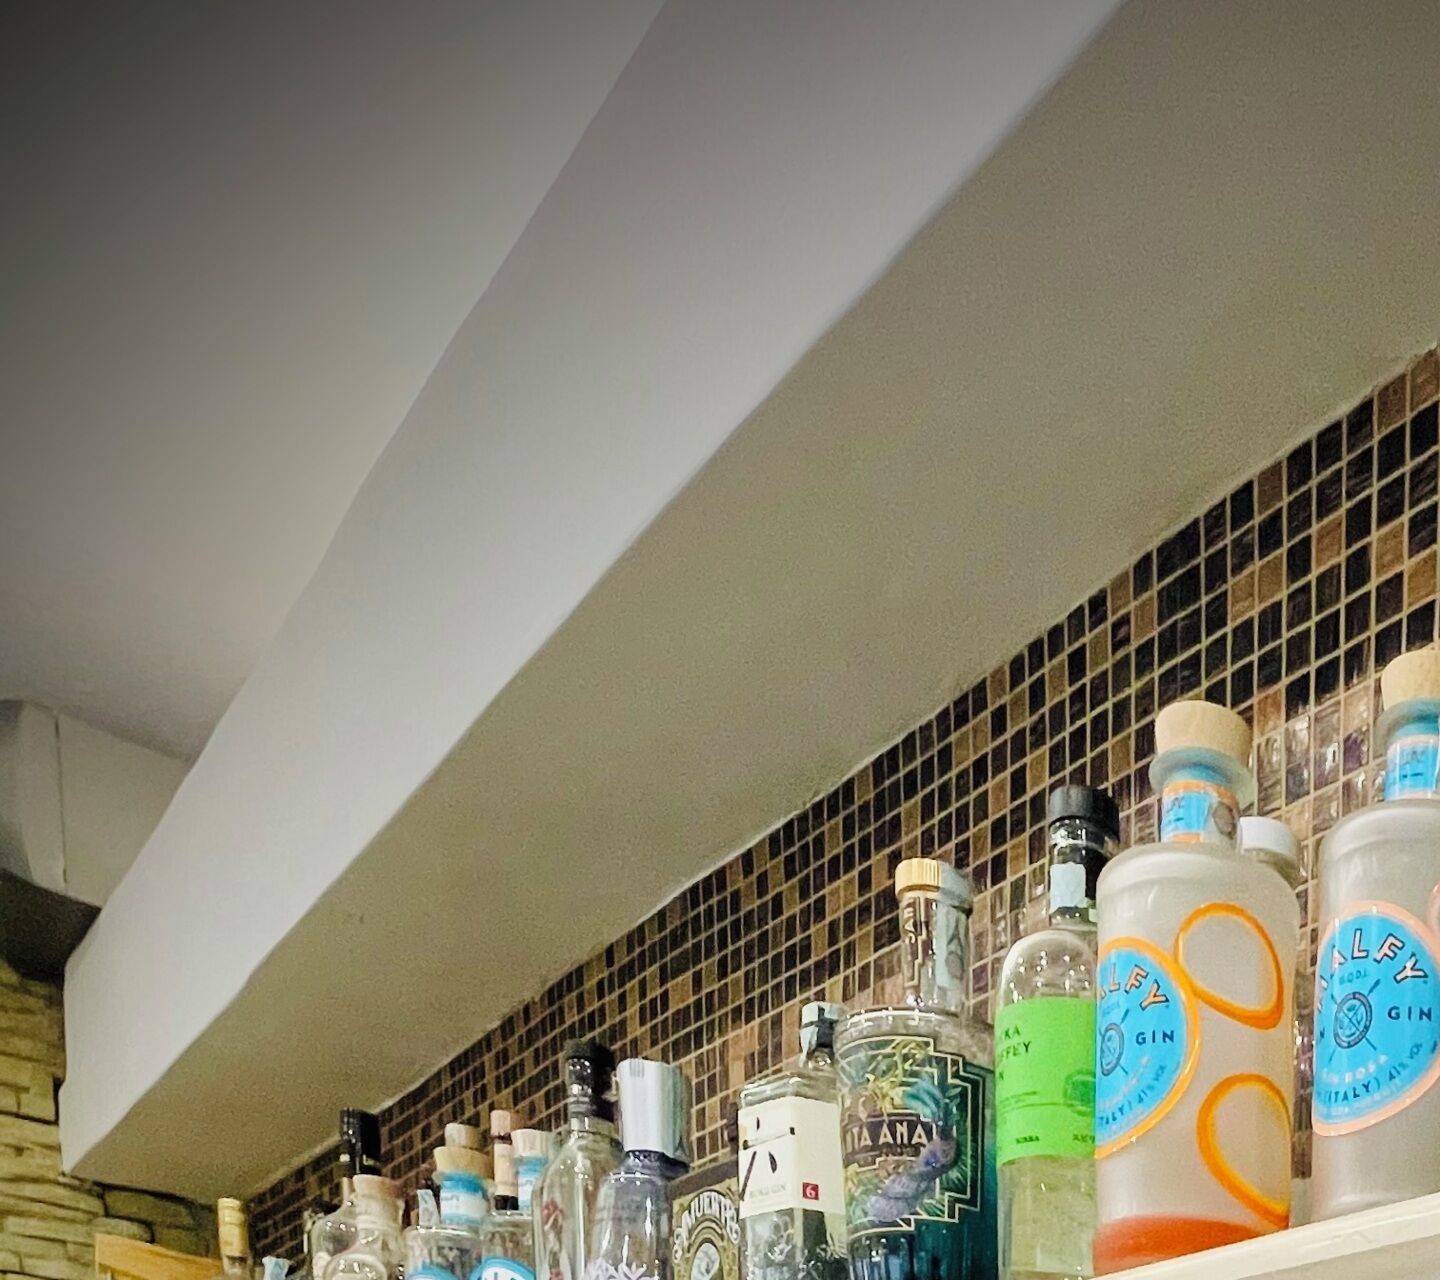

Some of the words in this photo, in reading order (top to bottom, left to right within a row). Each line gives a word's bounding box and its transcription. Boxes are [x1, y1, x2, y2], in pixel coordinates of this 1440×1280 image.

[1387, 1006, 1433, 1022] GIN
[1135, 1030, 1175, 1045] GIN
[805, 1186, 816, 1198] 6
